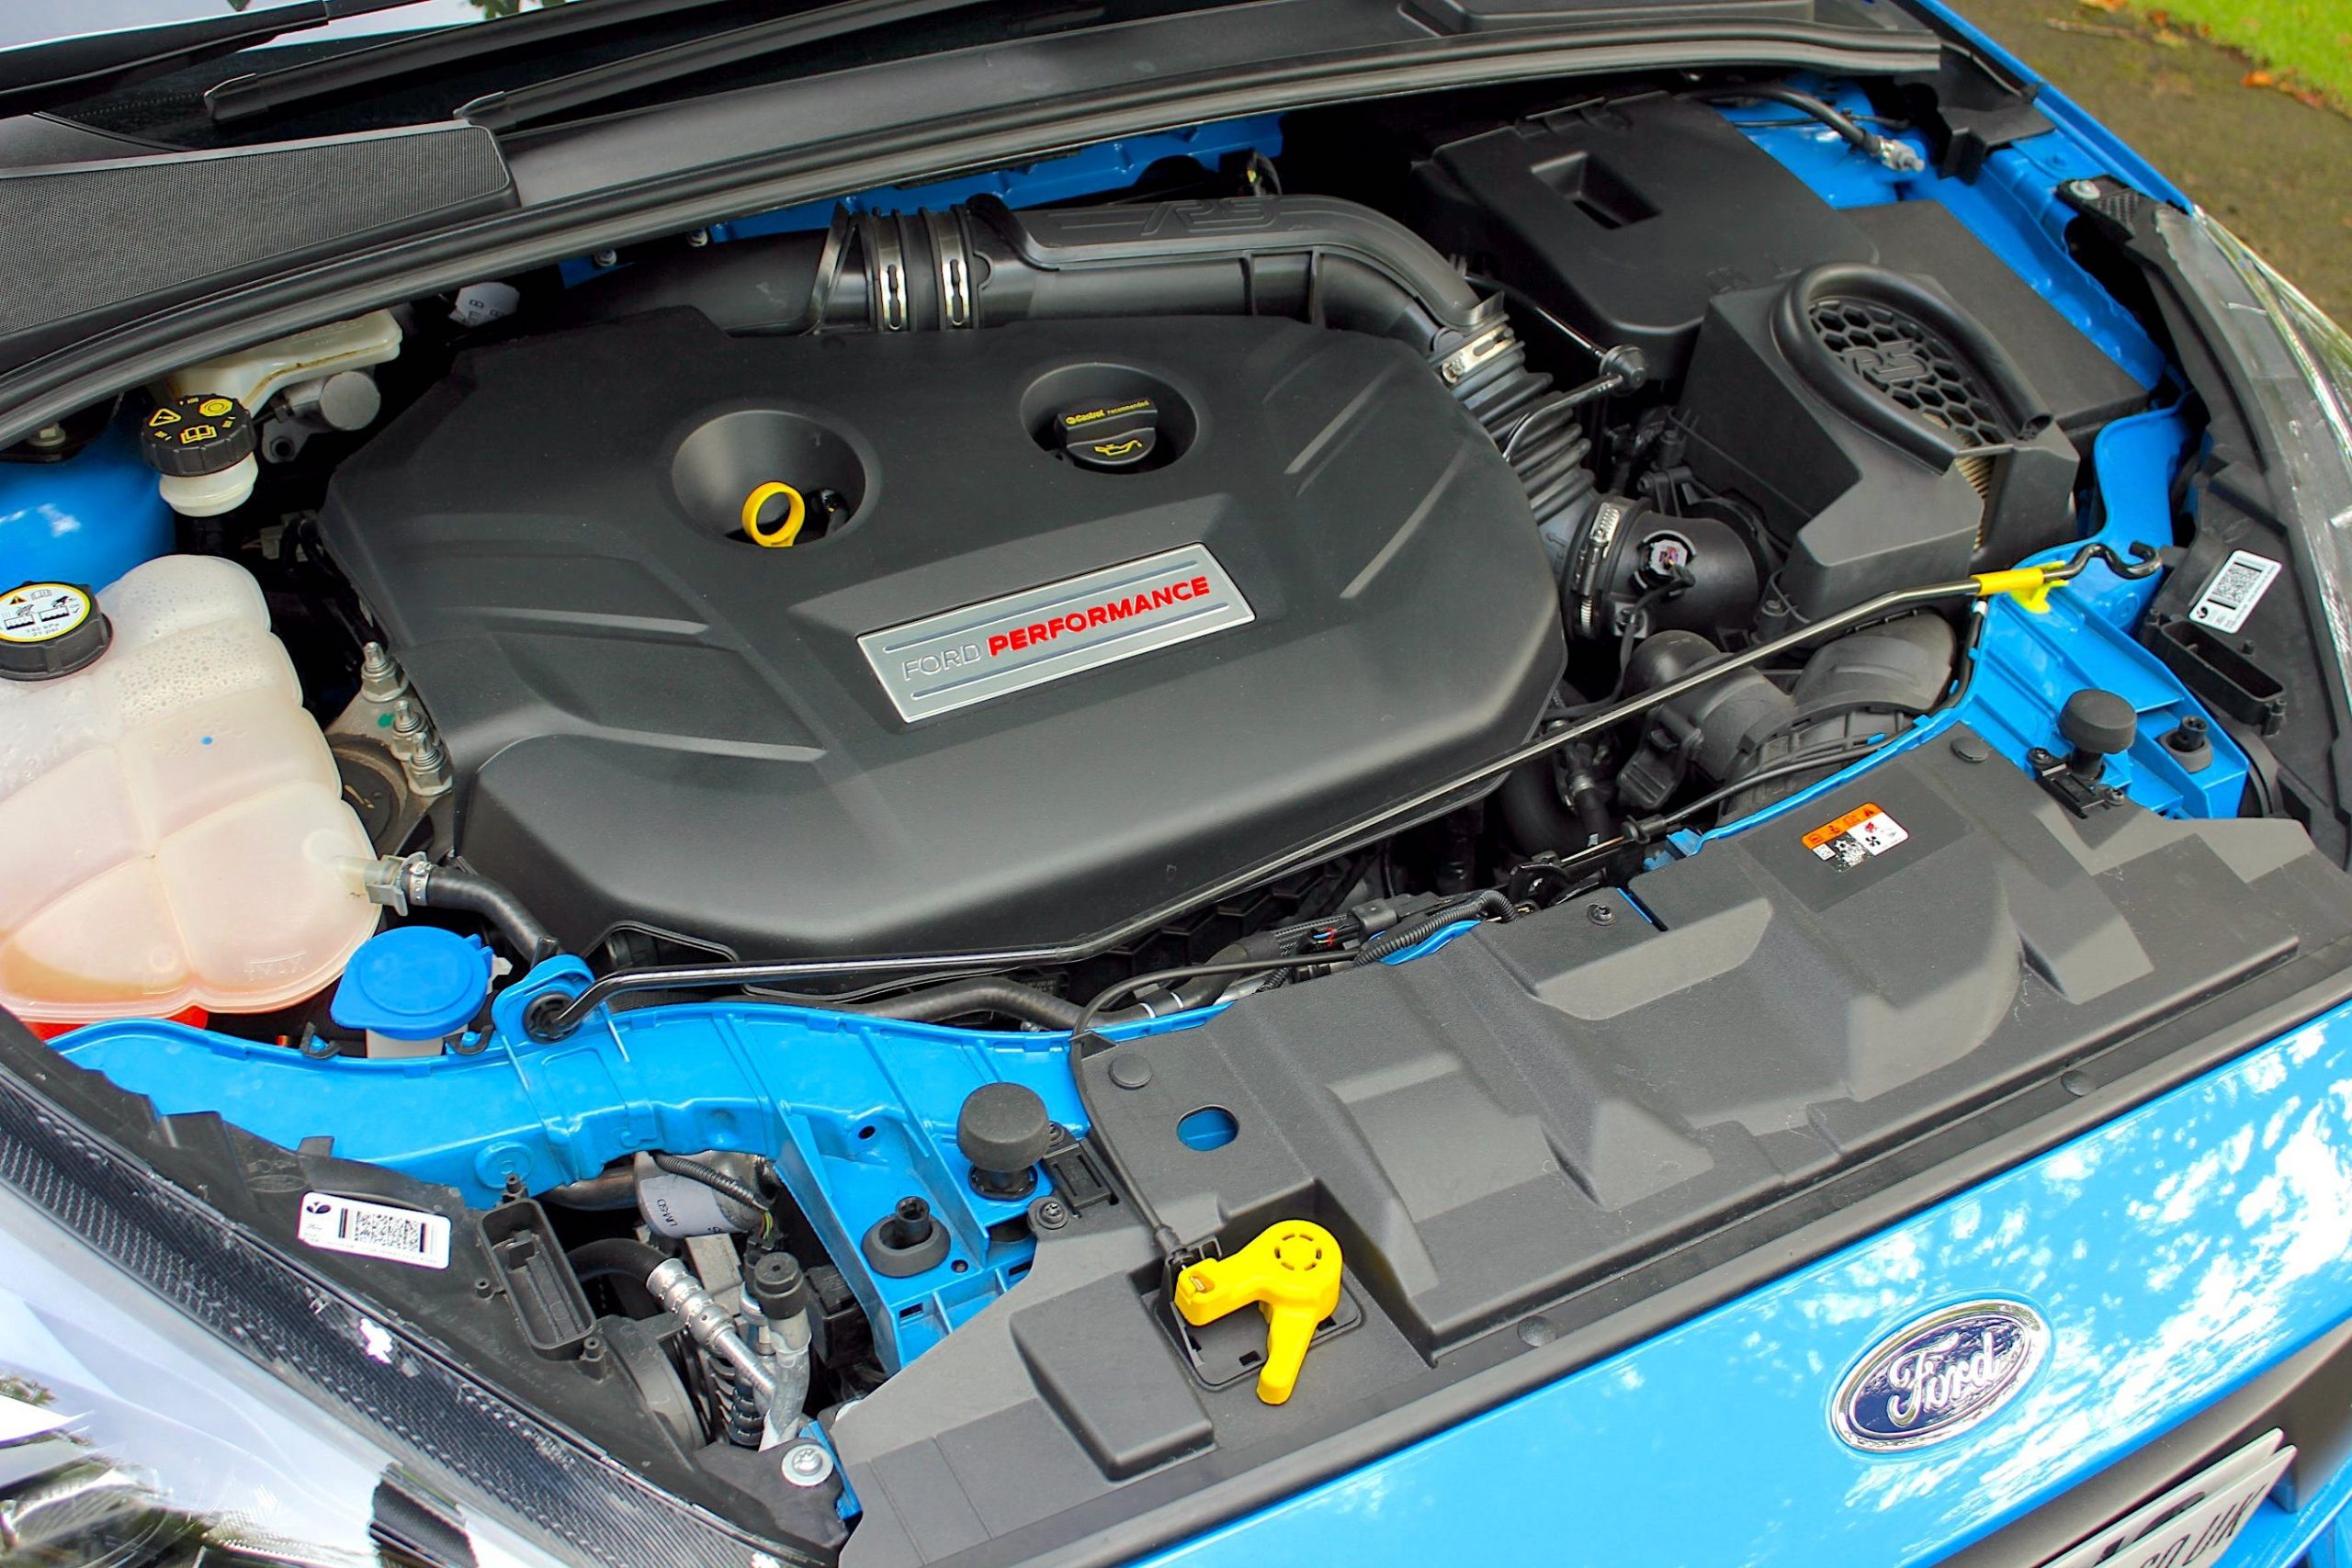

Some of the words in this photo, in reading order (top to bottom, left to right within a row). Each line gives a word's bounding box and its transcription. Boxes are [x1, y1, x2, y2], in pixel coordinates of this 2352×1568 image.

[1140, 195, 1278, 236] RS
[901, 643, 981, 682] FORD
[987, 576, 1210, 658] PERFORMANCE
[1887, 1332, 2000, 1427] Ford
